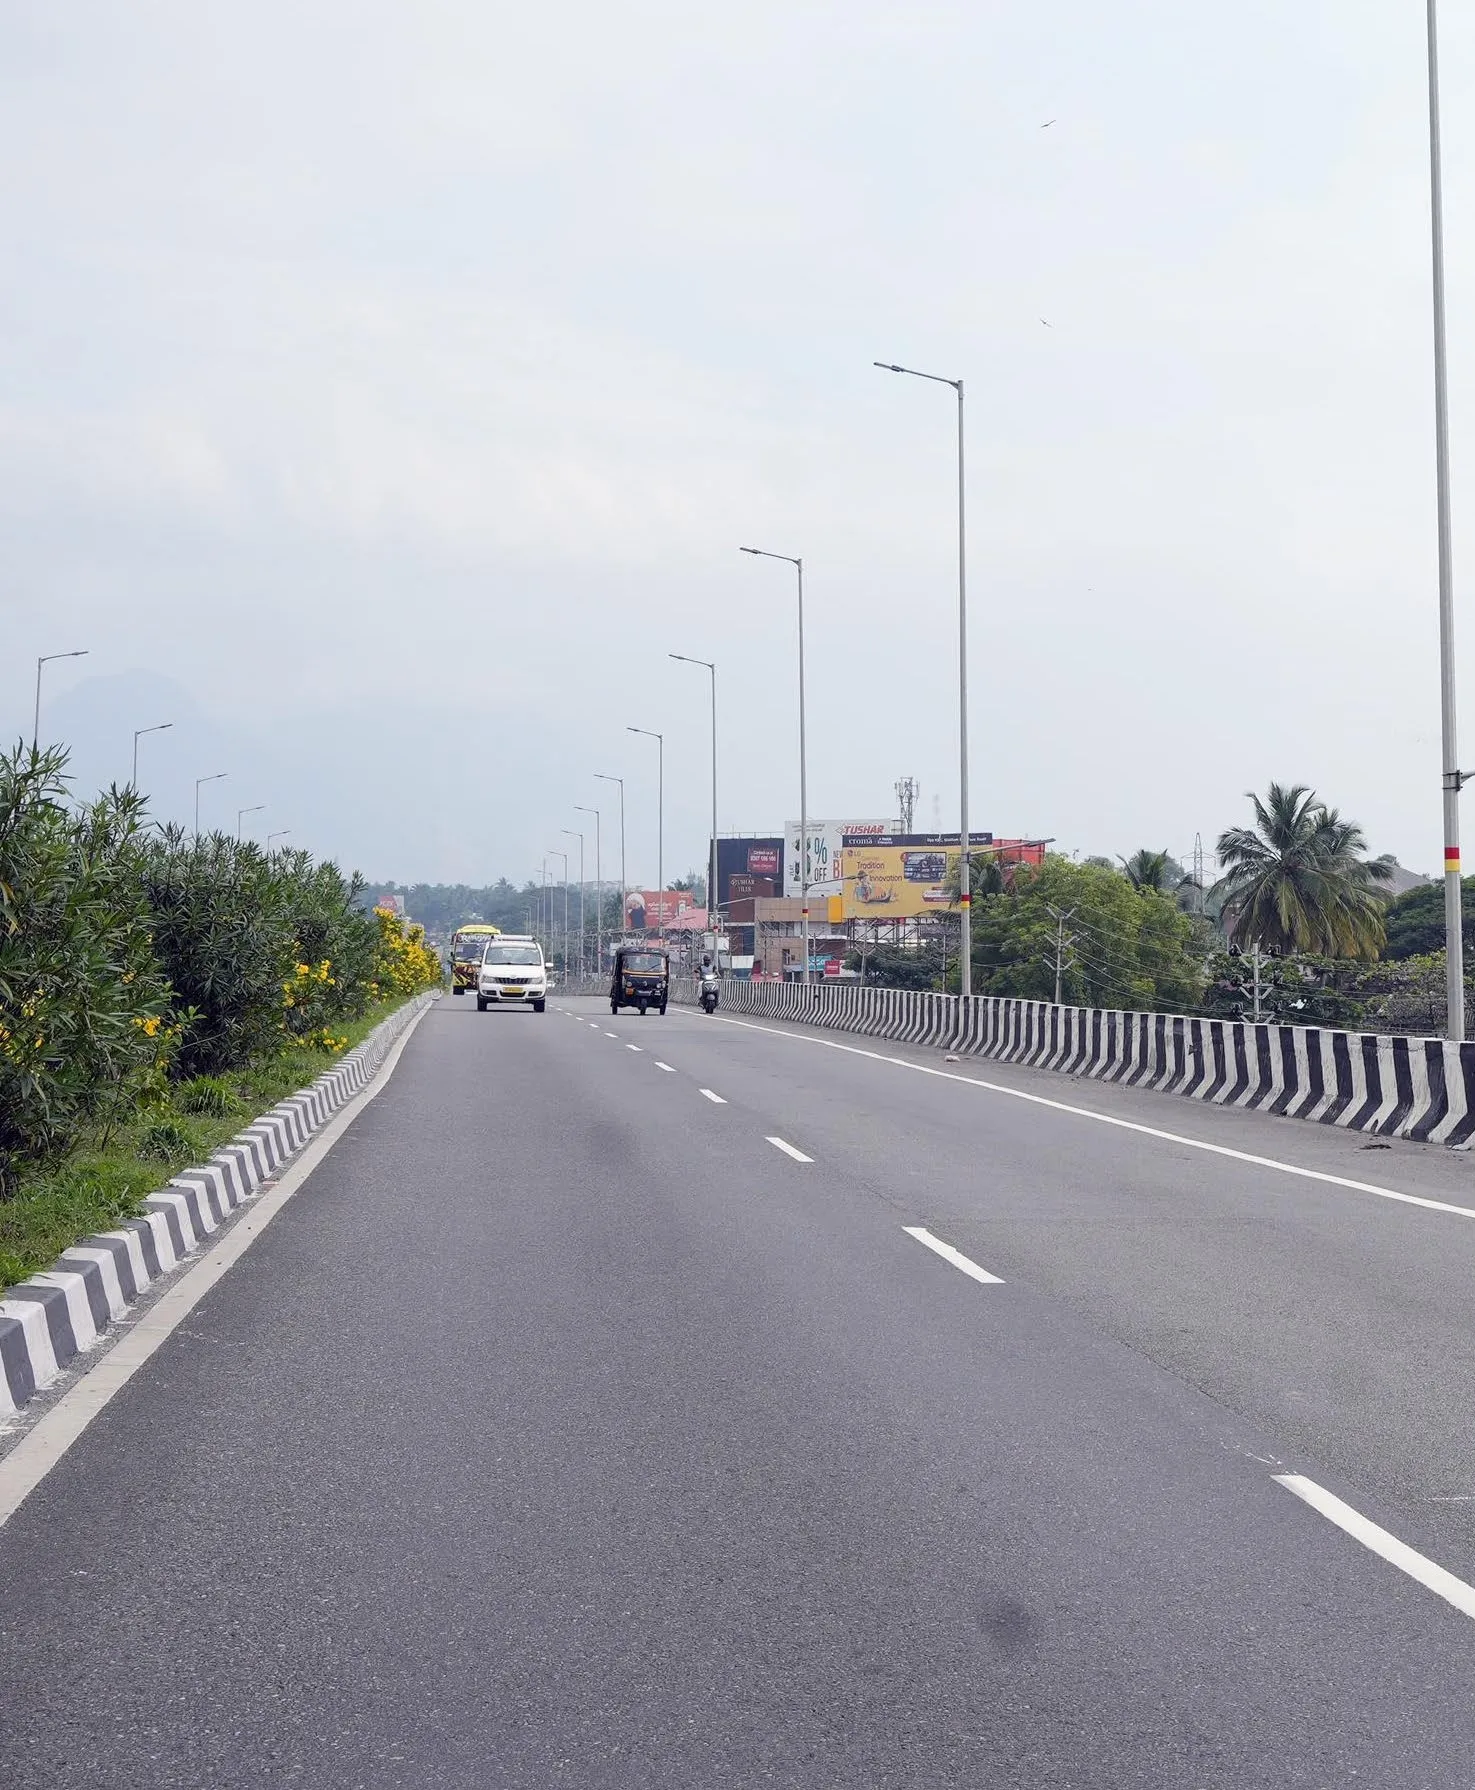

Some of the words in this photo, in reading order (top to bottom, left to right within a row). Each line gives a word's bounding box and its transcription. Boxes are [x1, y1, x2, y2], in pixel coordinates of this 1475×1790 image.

[844, 825, 885, 835] TUSHAR
[856, 861, 885, 870] Tradition
[814, 868, 827, 881] OFF
[869, 874, 903, 882] Innovation
